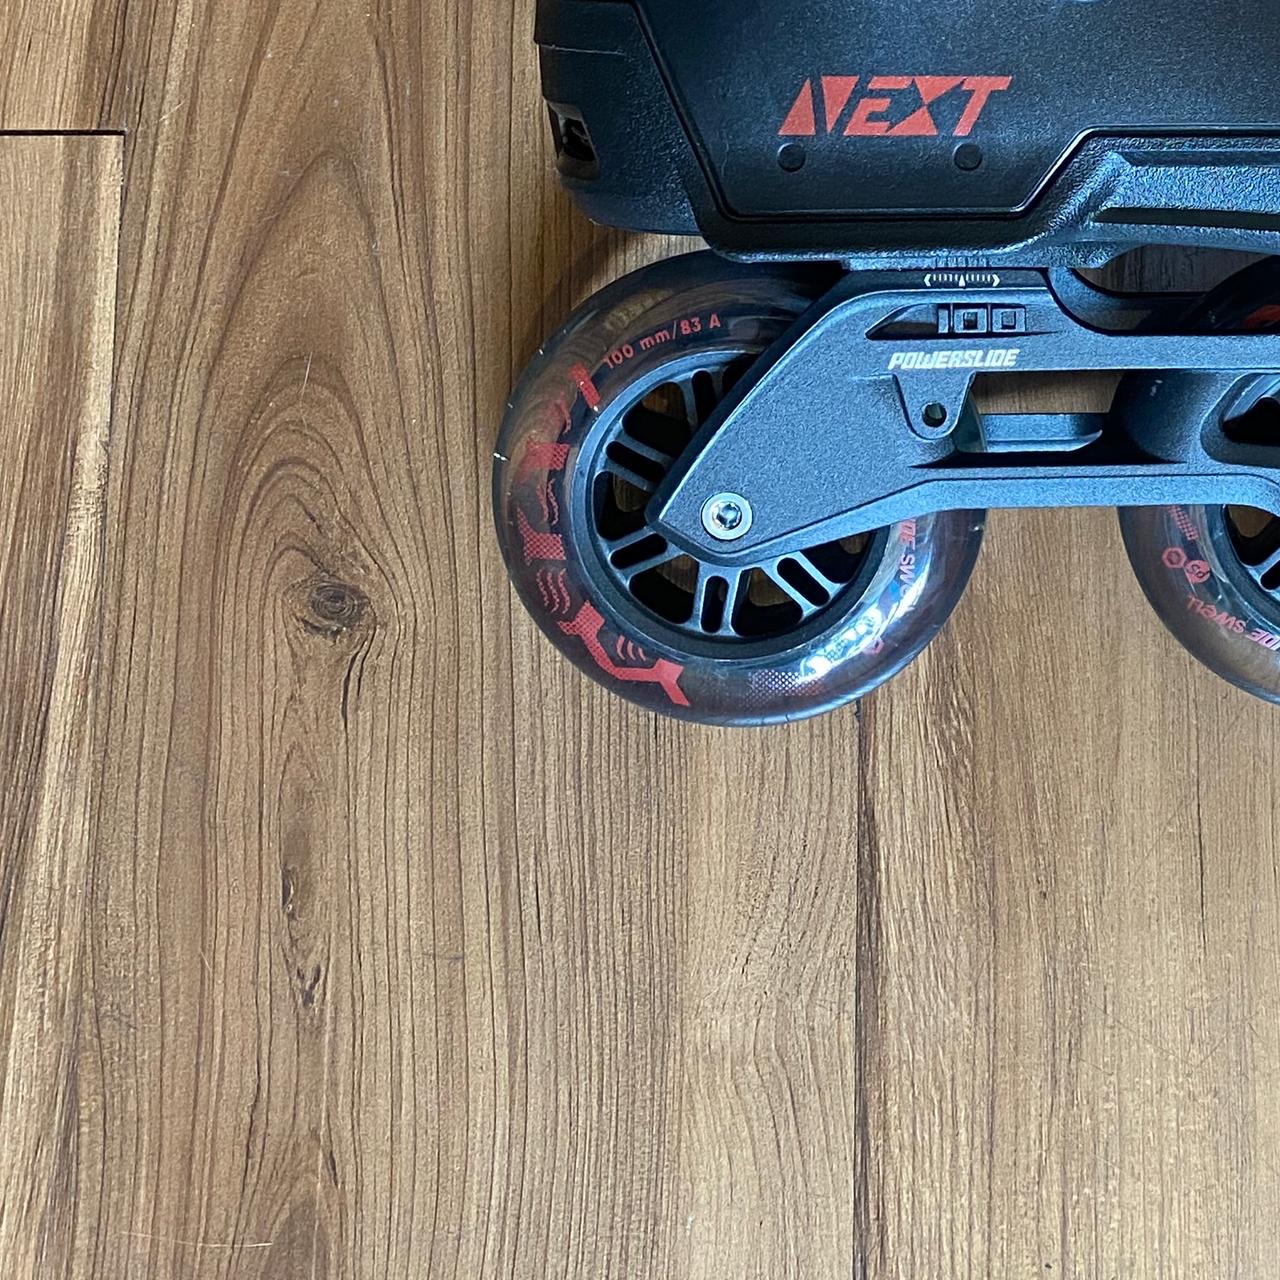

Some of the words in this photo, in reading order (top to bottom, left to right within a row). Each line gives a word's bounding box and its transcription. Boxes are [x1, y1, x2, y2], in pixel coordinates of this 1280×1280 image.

[777, 75, 1013, 136] NEXT
[938, 307, 1026, 333] 100
[602, 343, 634, 369] 100
[640, 317, 702, 350] mm/83
[709, 313, 721, 329] A
[887, 348, 1020, 370] POWERSLIDE
